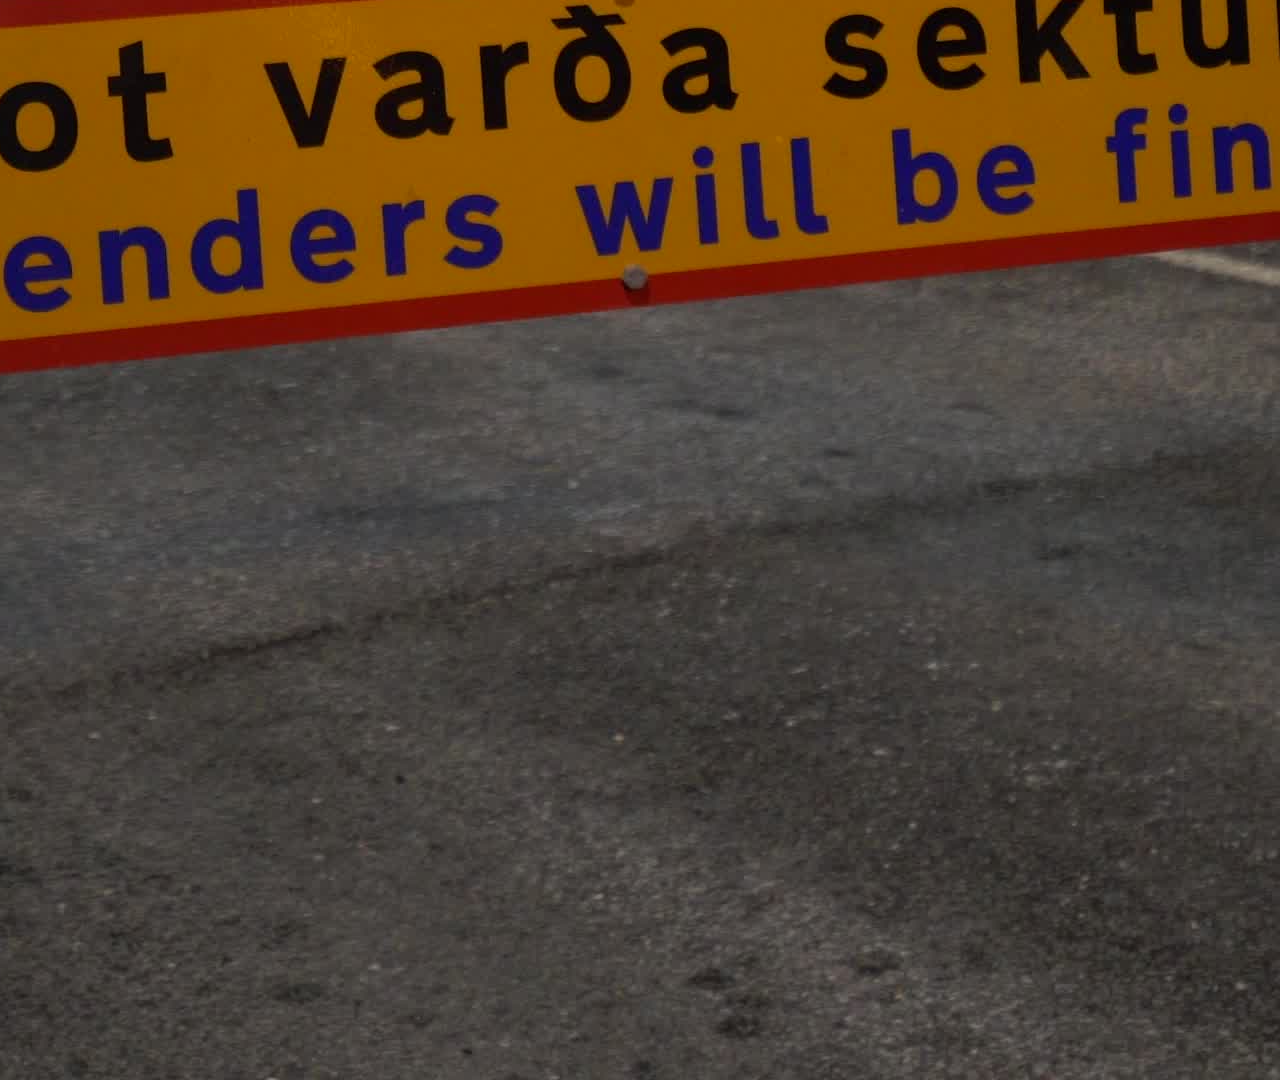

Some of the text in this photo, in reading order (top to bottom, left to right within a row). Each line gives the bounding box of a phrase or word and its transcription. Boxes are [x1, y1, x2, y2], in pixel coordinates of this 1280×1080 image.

[262, 4, 740, 149] varða
[574, 136, 830, 258] will
[891, 127, 1037, 227] be
